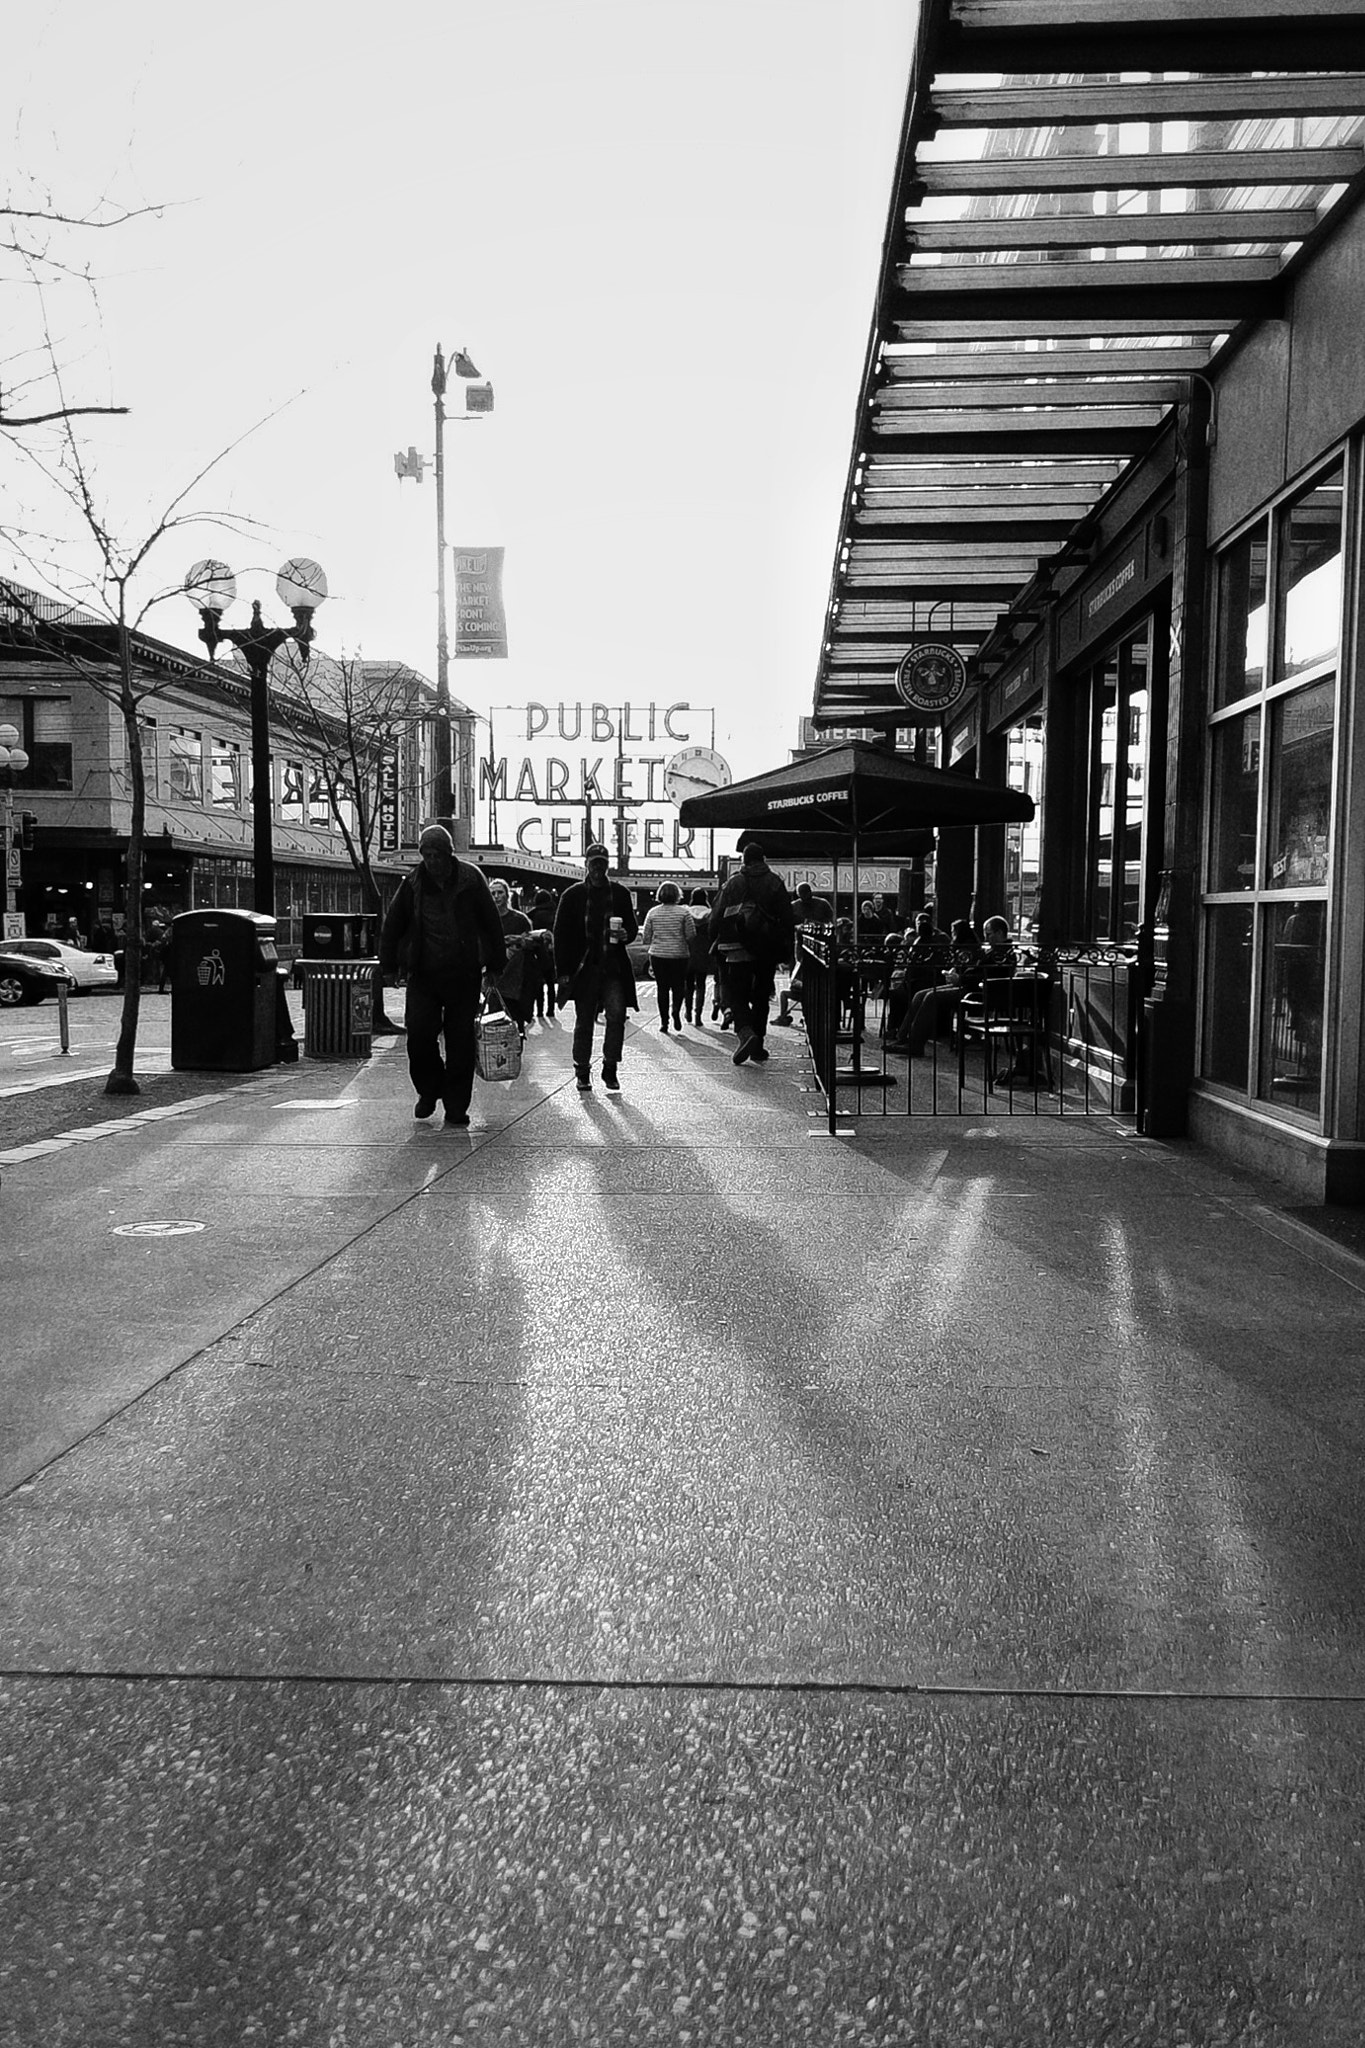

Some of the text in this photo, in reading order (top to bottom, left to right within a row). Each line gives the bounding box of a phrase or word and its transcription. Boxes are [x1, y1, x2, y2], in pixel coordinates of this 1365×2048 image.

[459, 595, 489, 606] ARKET
[464, 622, 499, 633] COMING
[910, 648, 956, 664] STARBUCKS
[903, 669, 914, 695] FRESH
[912, 694, 949, 707] ROASTED
[527, 702, 690, 741] PUBLIC
[479, 757, 665, 801] MARKET
[767, 790, 849, 810] STARBUCKS COFFEE
[381, 804, 395, 849] HOTEL
[516, 817, 695, 859] CENTER
